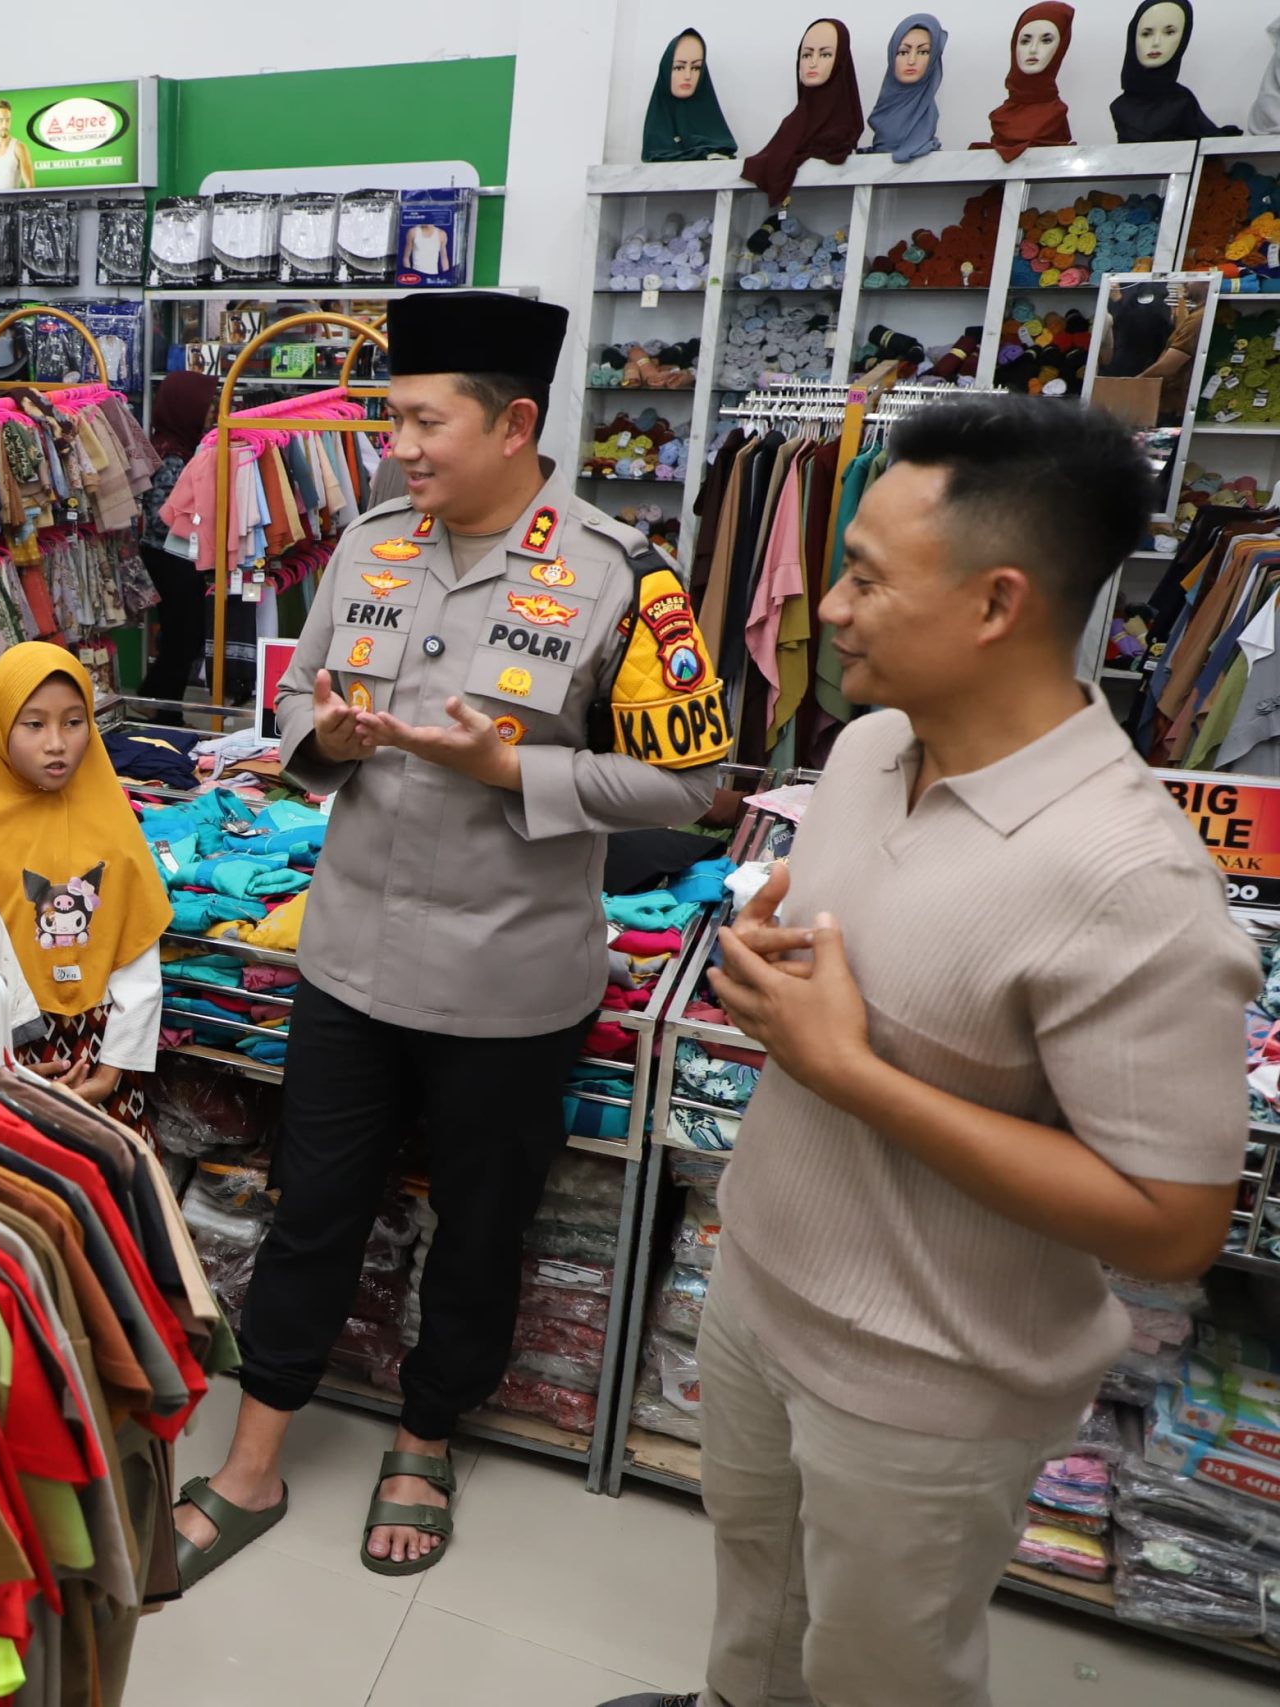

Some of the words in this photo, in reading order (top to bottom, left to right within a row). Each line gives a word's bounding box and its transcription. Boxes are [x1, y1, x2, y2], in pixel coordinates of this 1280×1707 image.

[66, 116, 107, 132] Agree
[346, 602, 403, 629] ERIK
[647, 596, 685, 617] POLRES
[488, 623, 572, 663] POLRI
[619, 709, 663, 760] KA
[667, 689, 734, 757] OPS
[1164, 780, 1239, 816] BIG
[1198, 816, 1253, 850] LE
[1215, 854, 1263, 871] NAK
[1226, 882, 1260, 901] 00
